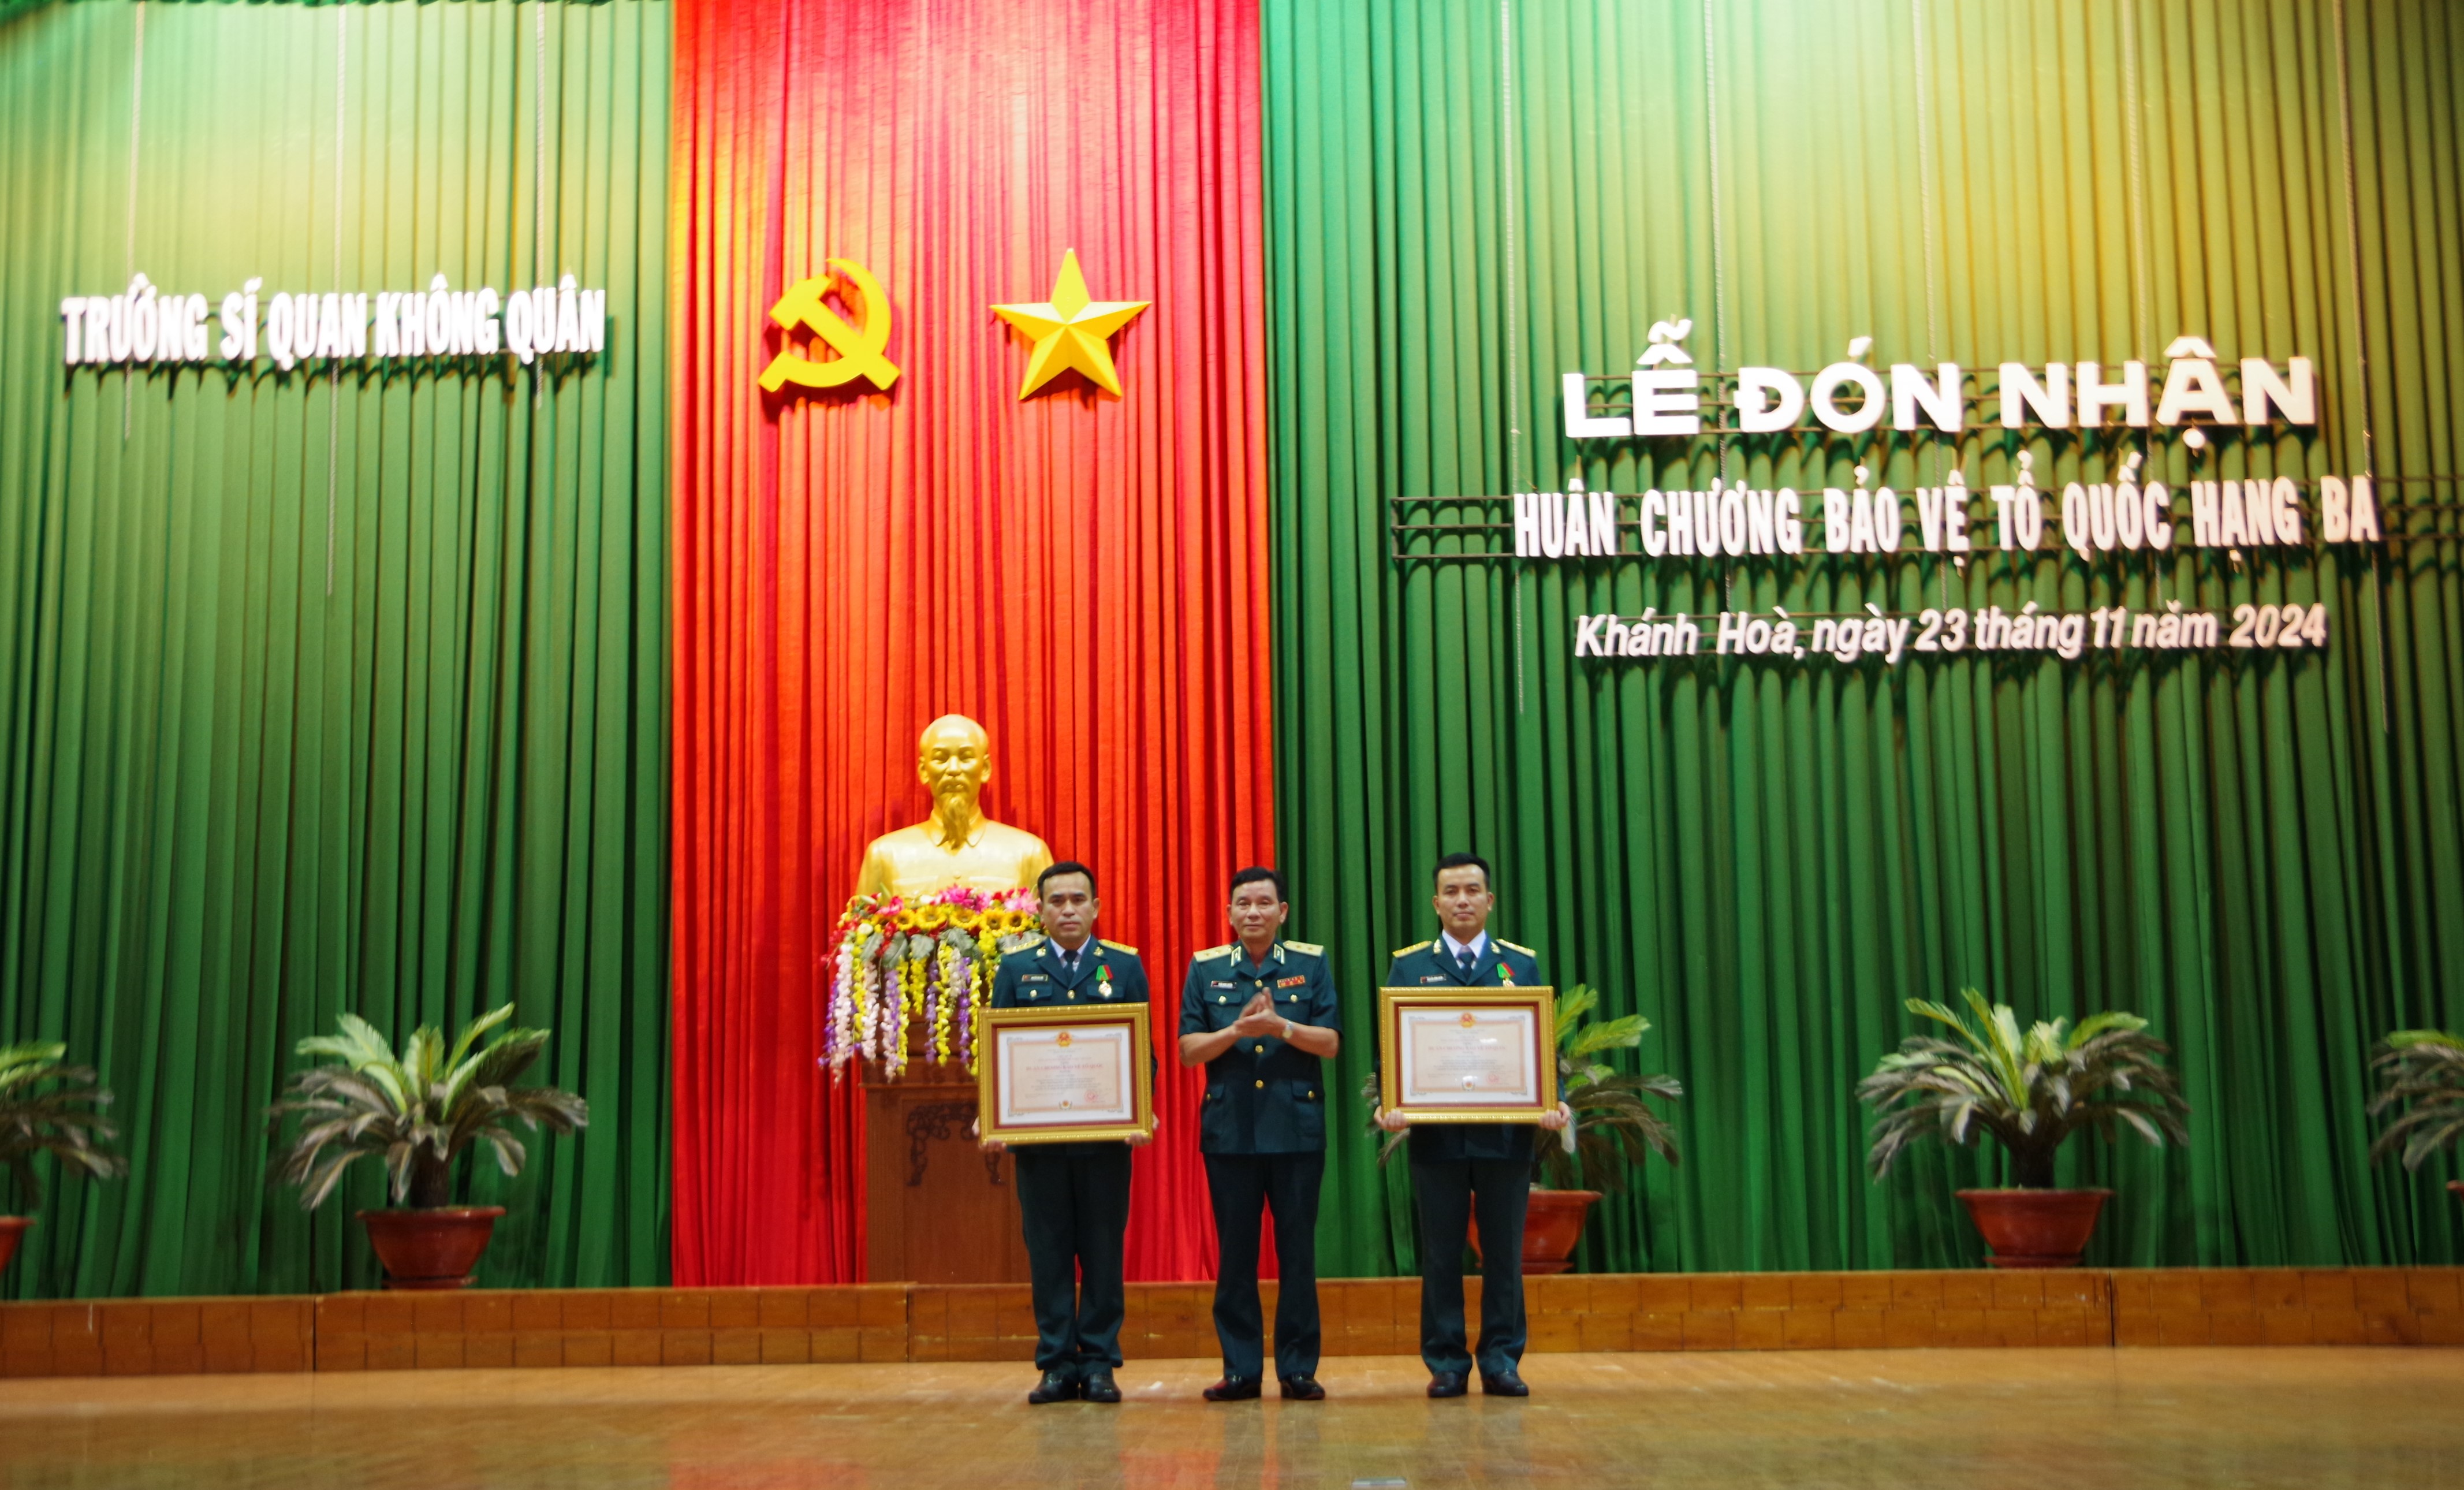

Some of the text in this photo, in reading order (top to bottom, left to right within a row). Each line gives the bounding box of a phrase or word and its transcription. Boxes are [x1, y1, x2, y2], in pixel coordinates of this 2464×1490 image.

[267, 292, 368, 371] QUAN
[374, 273, 500, 356] KHÔNG
[506, 273, 605, 365] QUÂN
[1563, 315, 2314, 448] LỄ ĐÓN NHẬN
[1514, 450, 2379, 567] HUÂN CHƯƠNG BẢO VỆ TỔ QUỐC HẠNG BA
[1575, 600, 2326, 664] Khánh Hoà, ngày 23 tháng 11 năm 2024
